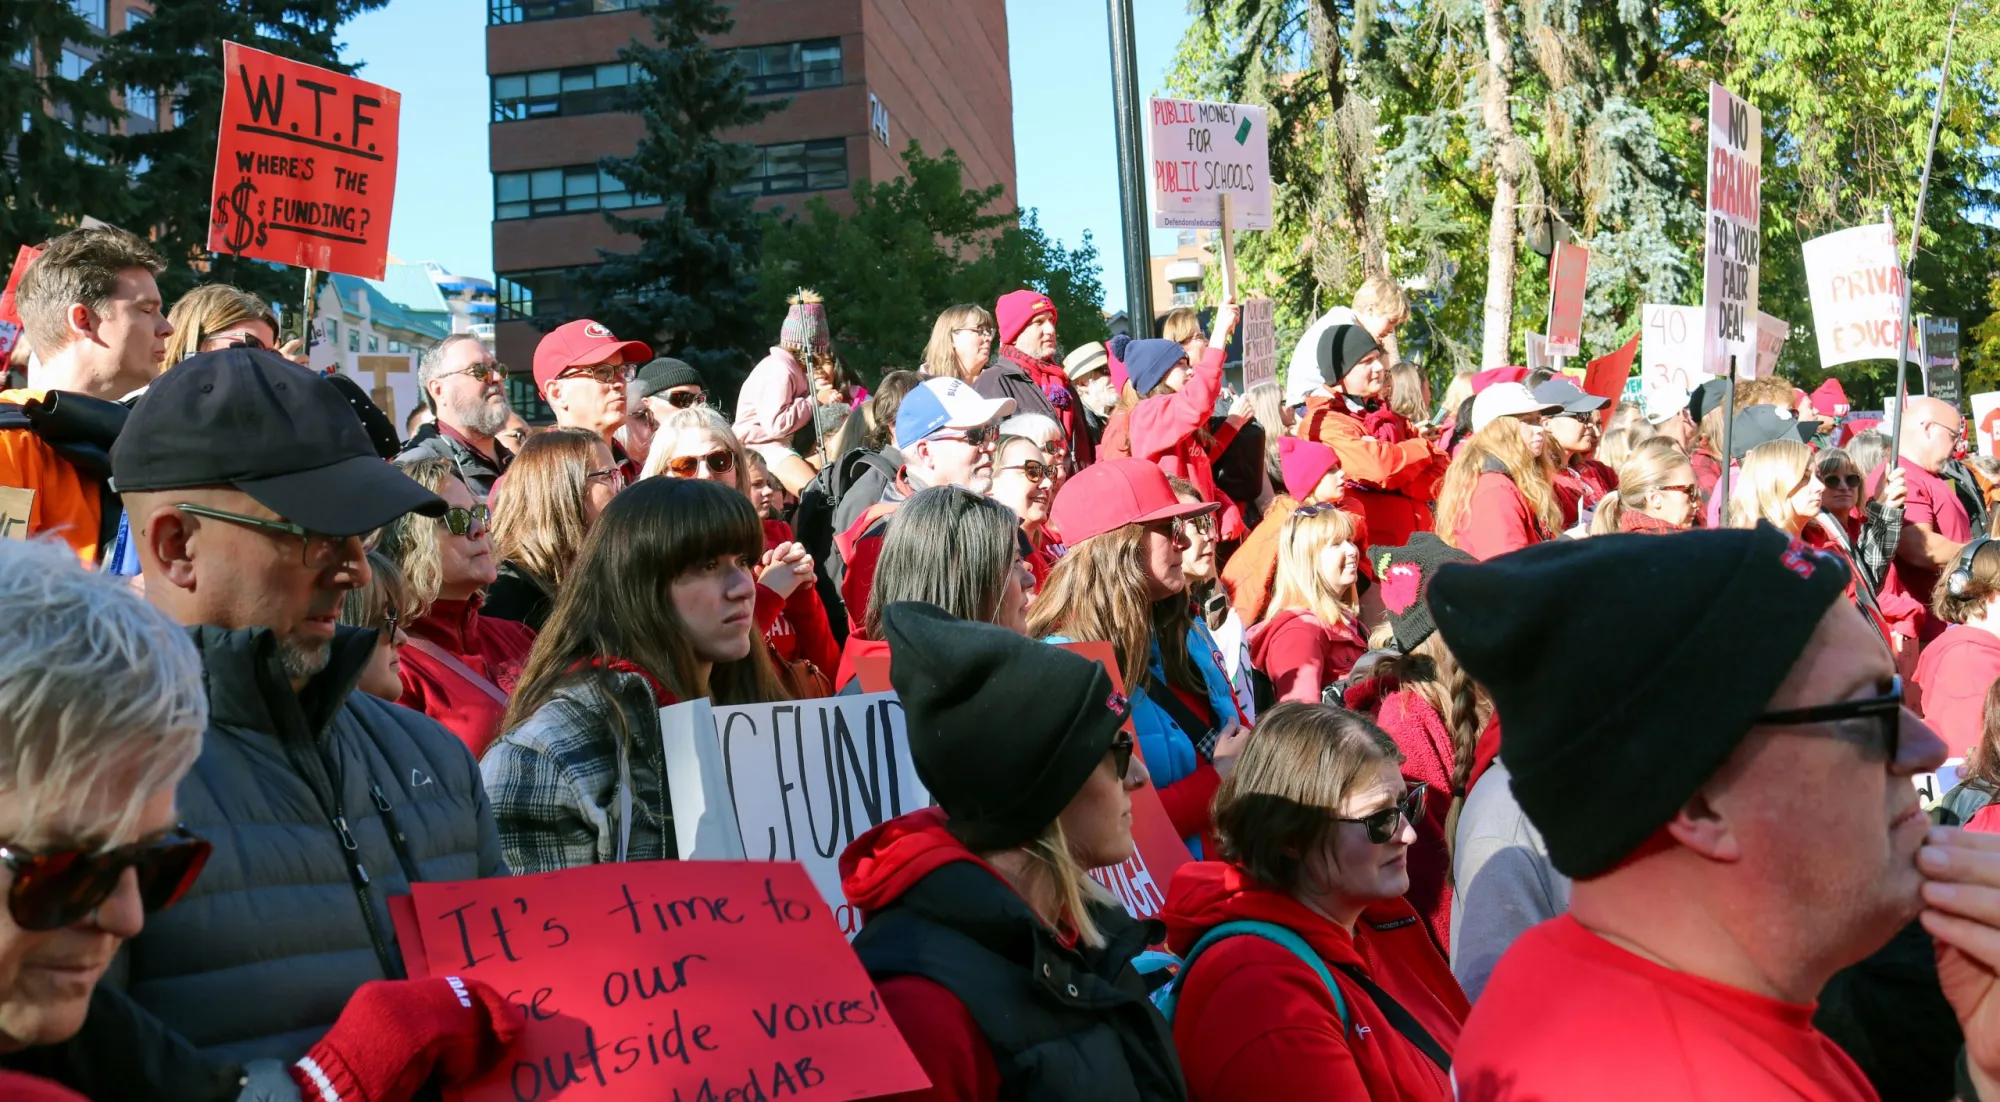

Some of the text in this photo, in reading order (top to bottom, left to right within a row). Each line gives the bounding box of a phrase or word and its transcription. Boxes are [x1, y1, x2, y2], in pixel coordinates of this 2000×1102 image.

[239, 64, 381, 152] W.T.F.
[868, 92, 890, 148] 744
[1154, 100, 1237, 126] PUBLIC MONEY
[1728, 97, 1748, 150] NO
[235, 151, 368, 195] WHERE'S THE
[1155, 160, 1255, 193] PUBLIC SCHOOLS
[1711, 146, 1760, 226] SPANKS
[272, 197, 370, 236] FUNDING?
[1714, 216, 1759, 266] TO YOUR
[1651, 309, 1687, 345] 40
[1719, 301, 1745, 343] DEAL
[438, 897, 569, 970] It's
[608, 884, 745, 934] time
[763, 879, 812, 925] to
[603, 954, 708, 1008] our
[511, 990, 886, 1102] outside voices!
